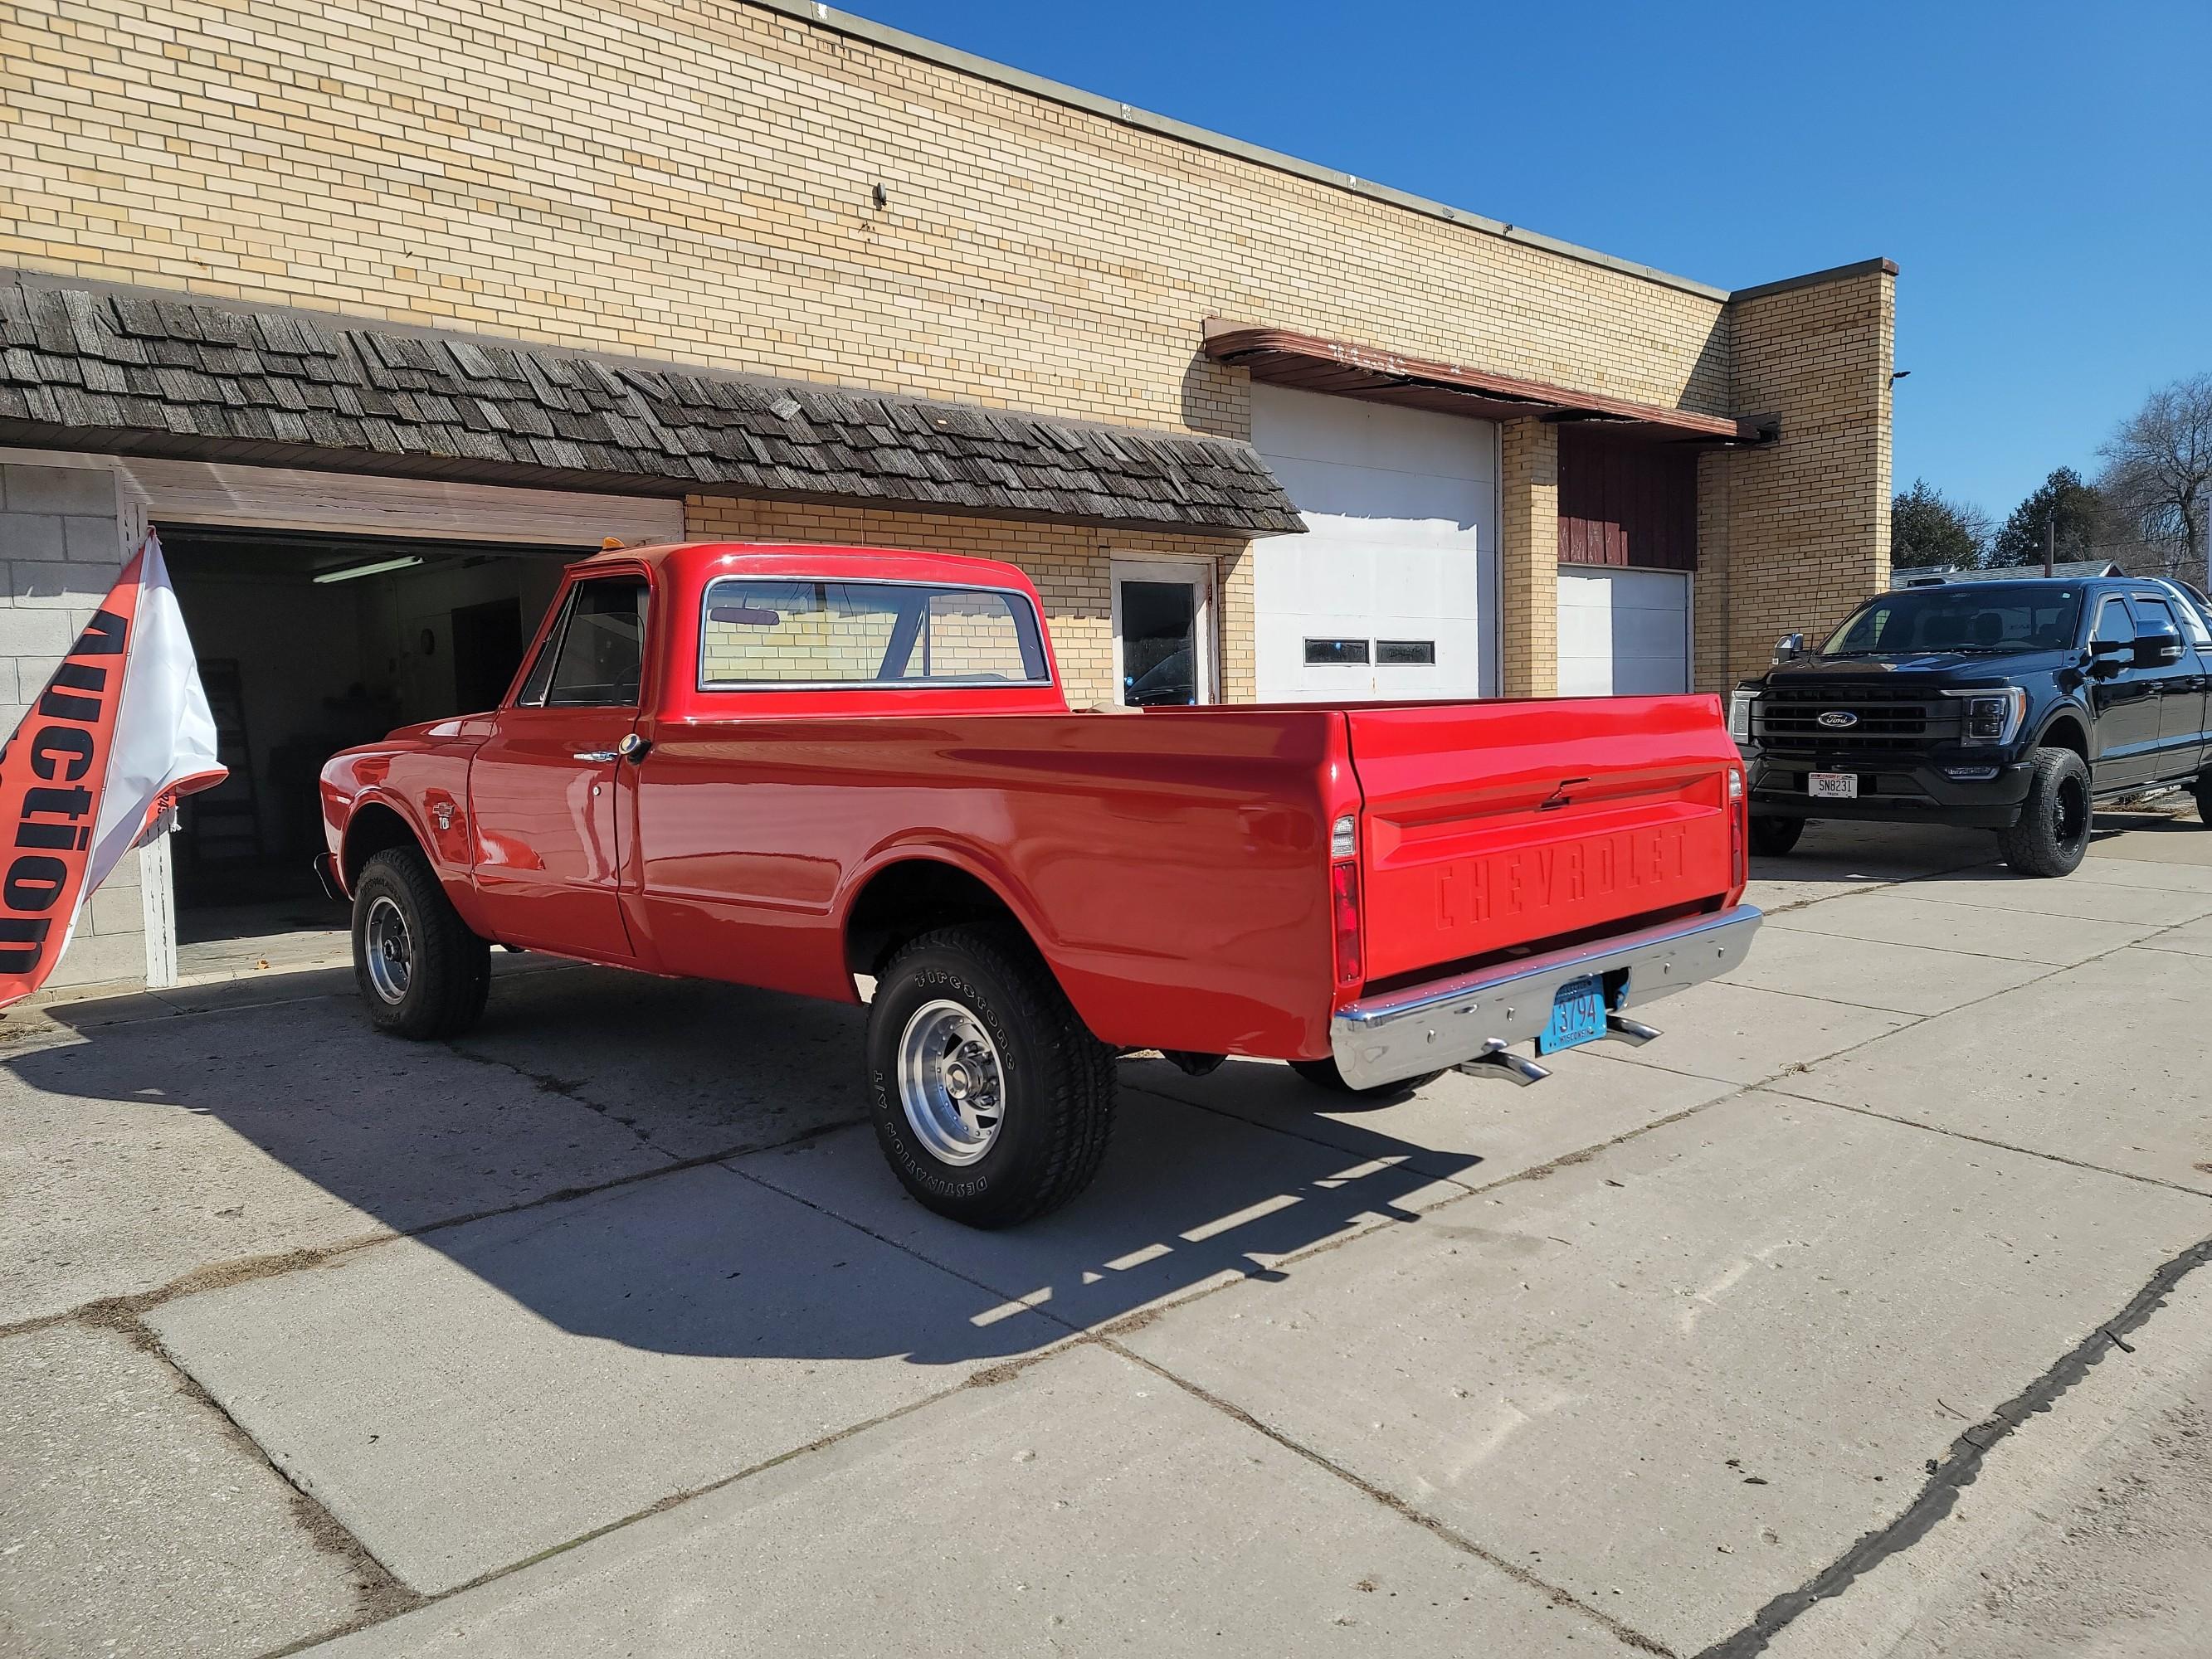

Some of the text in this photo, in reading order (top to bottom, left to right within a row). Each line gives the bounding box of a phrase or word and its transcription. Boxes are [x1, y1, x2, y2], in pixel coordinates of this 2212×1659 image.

[1826, 714, 1848, 724] Ford
[0, 609, 128, 975] Auction
[1819, 780, 1852, 792] SN8231
[1436, 825, 1687, 931] CHEVROLET
[1560, 1028, 1592, 1043] WISCONSIN
[874, 1070, 988, 1196] DESTINATION A/T
